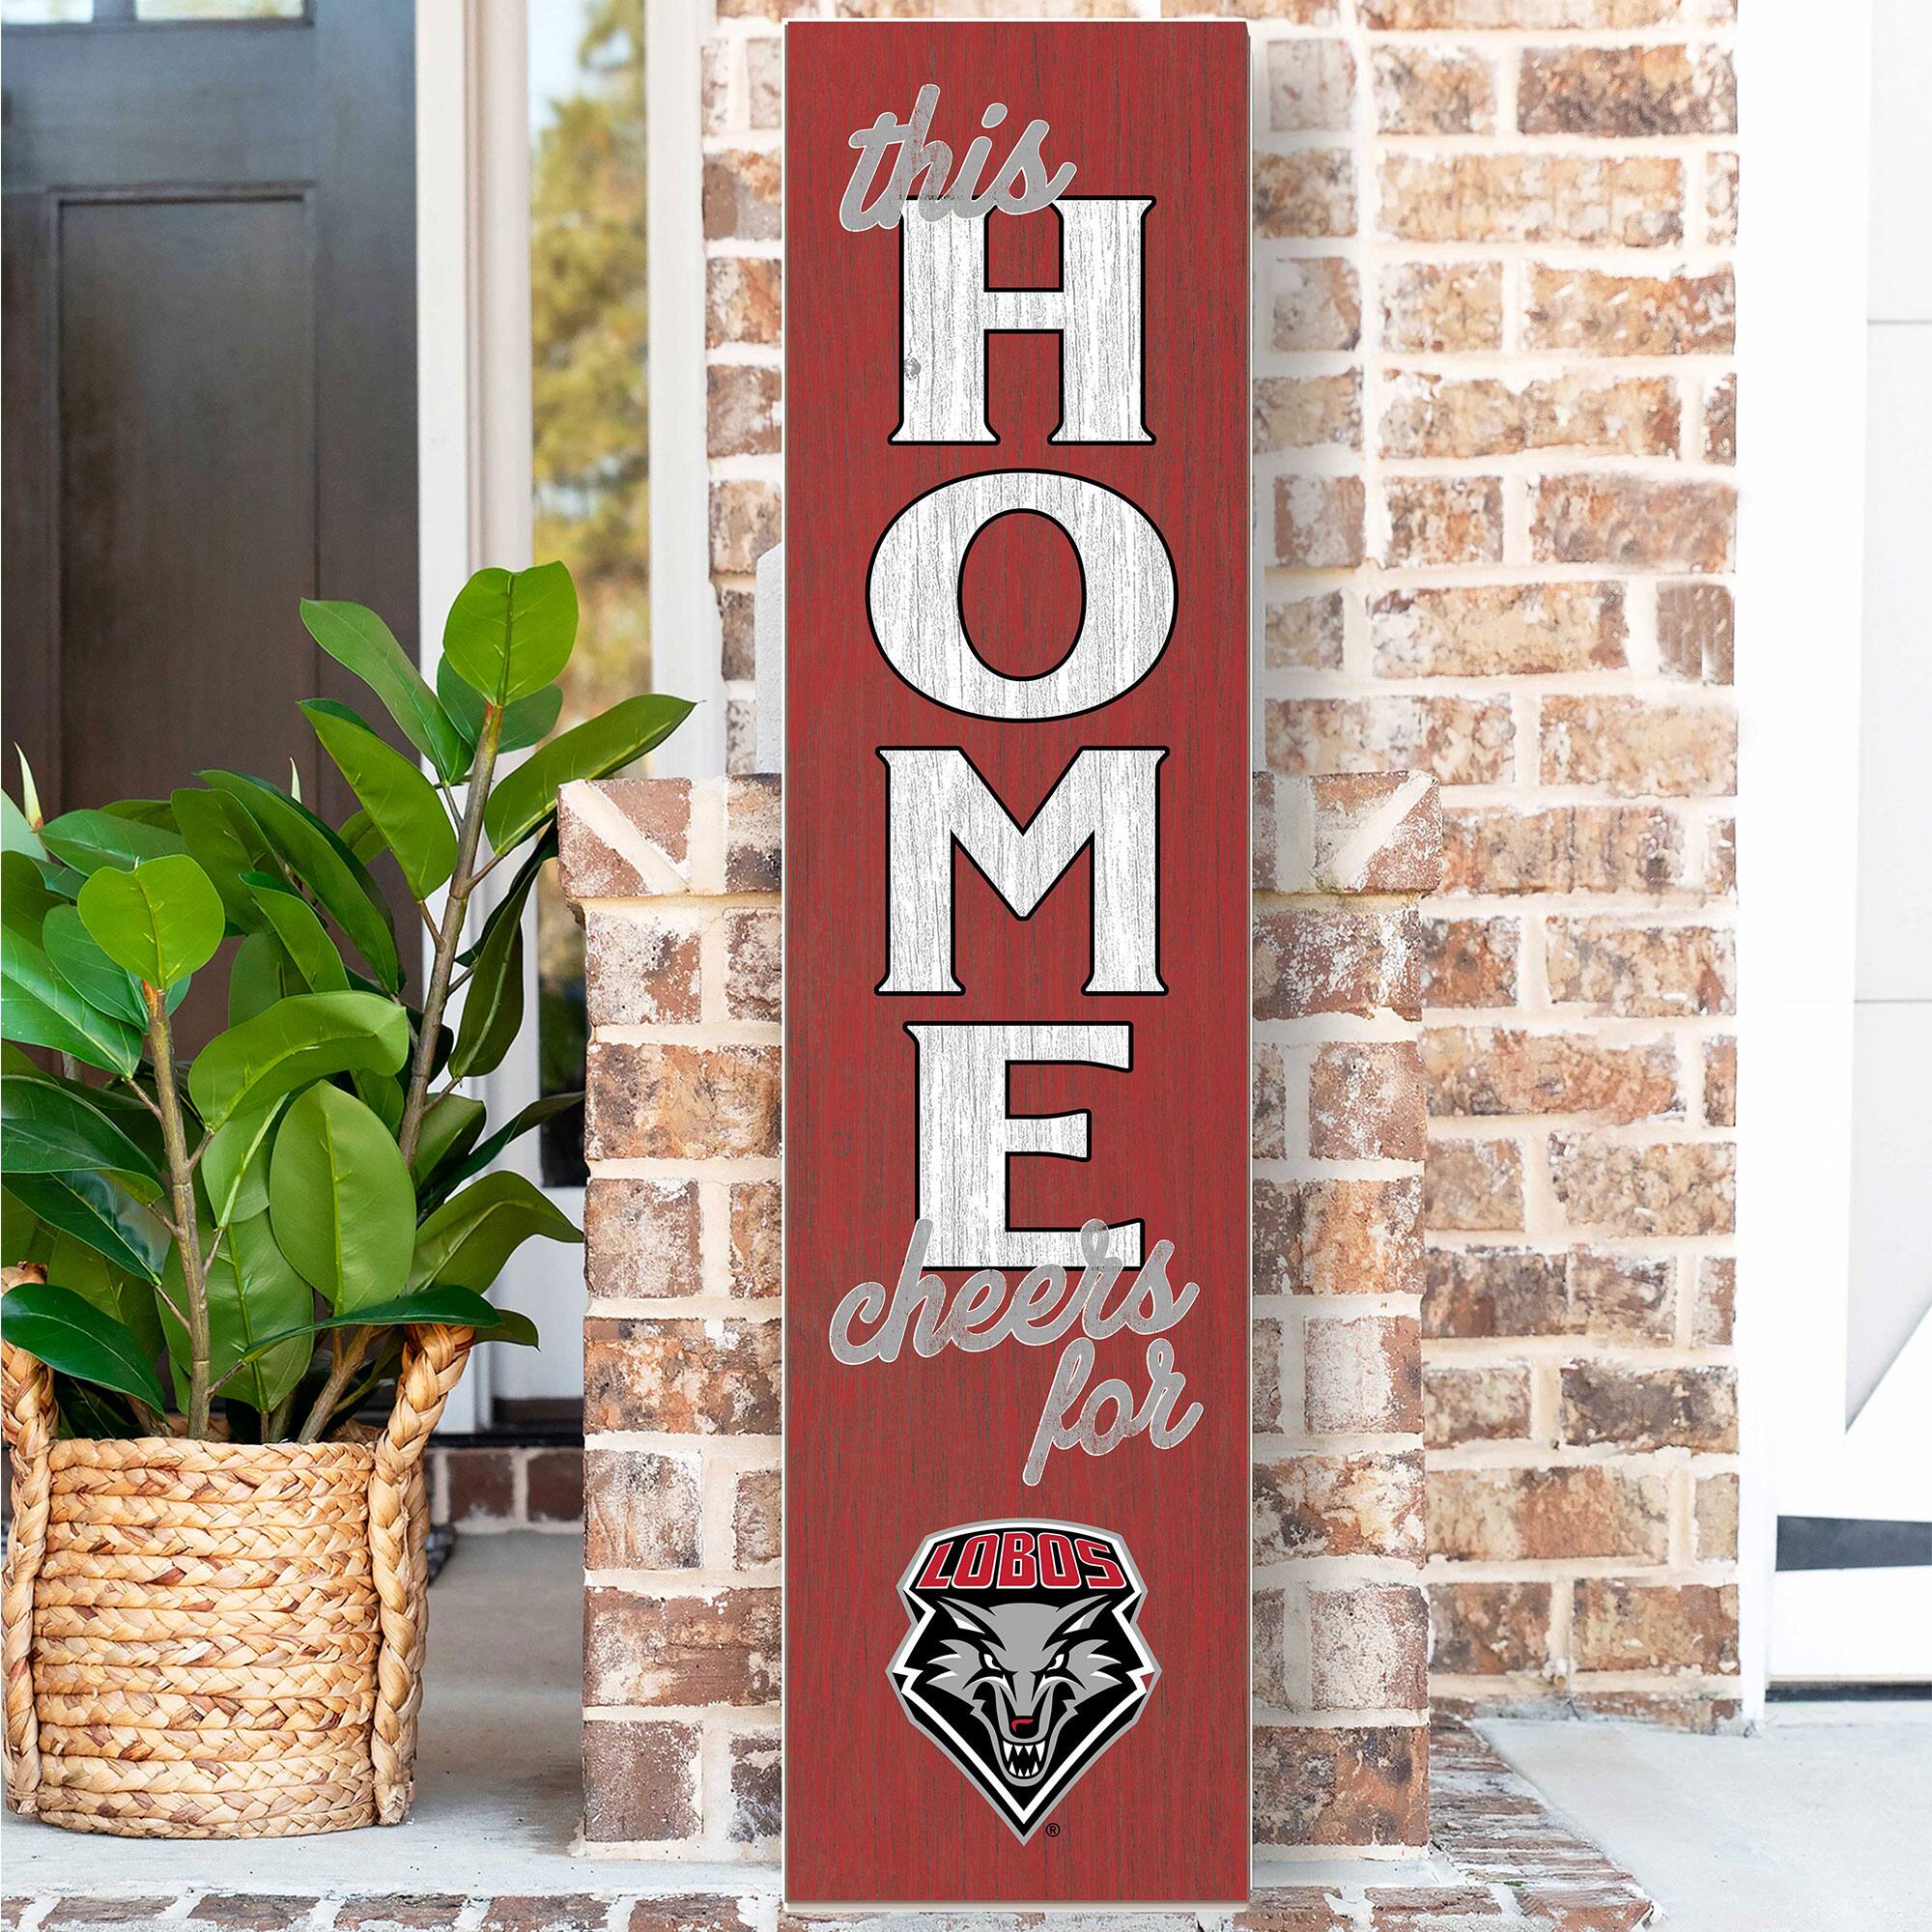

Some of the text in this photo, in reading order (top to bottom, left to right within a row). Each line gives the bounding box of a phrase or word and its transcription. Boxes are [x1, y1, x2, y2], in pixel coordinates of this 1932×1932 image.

[839, 83, 1077, 233] this
[865, 195, 1179, 1272] HOME
[829, 1218, 1201, 1366] cheers
[1022, 1337, 1204, 1487] for
[916, 1531, 1127, 1589] LOBOS
